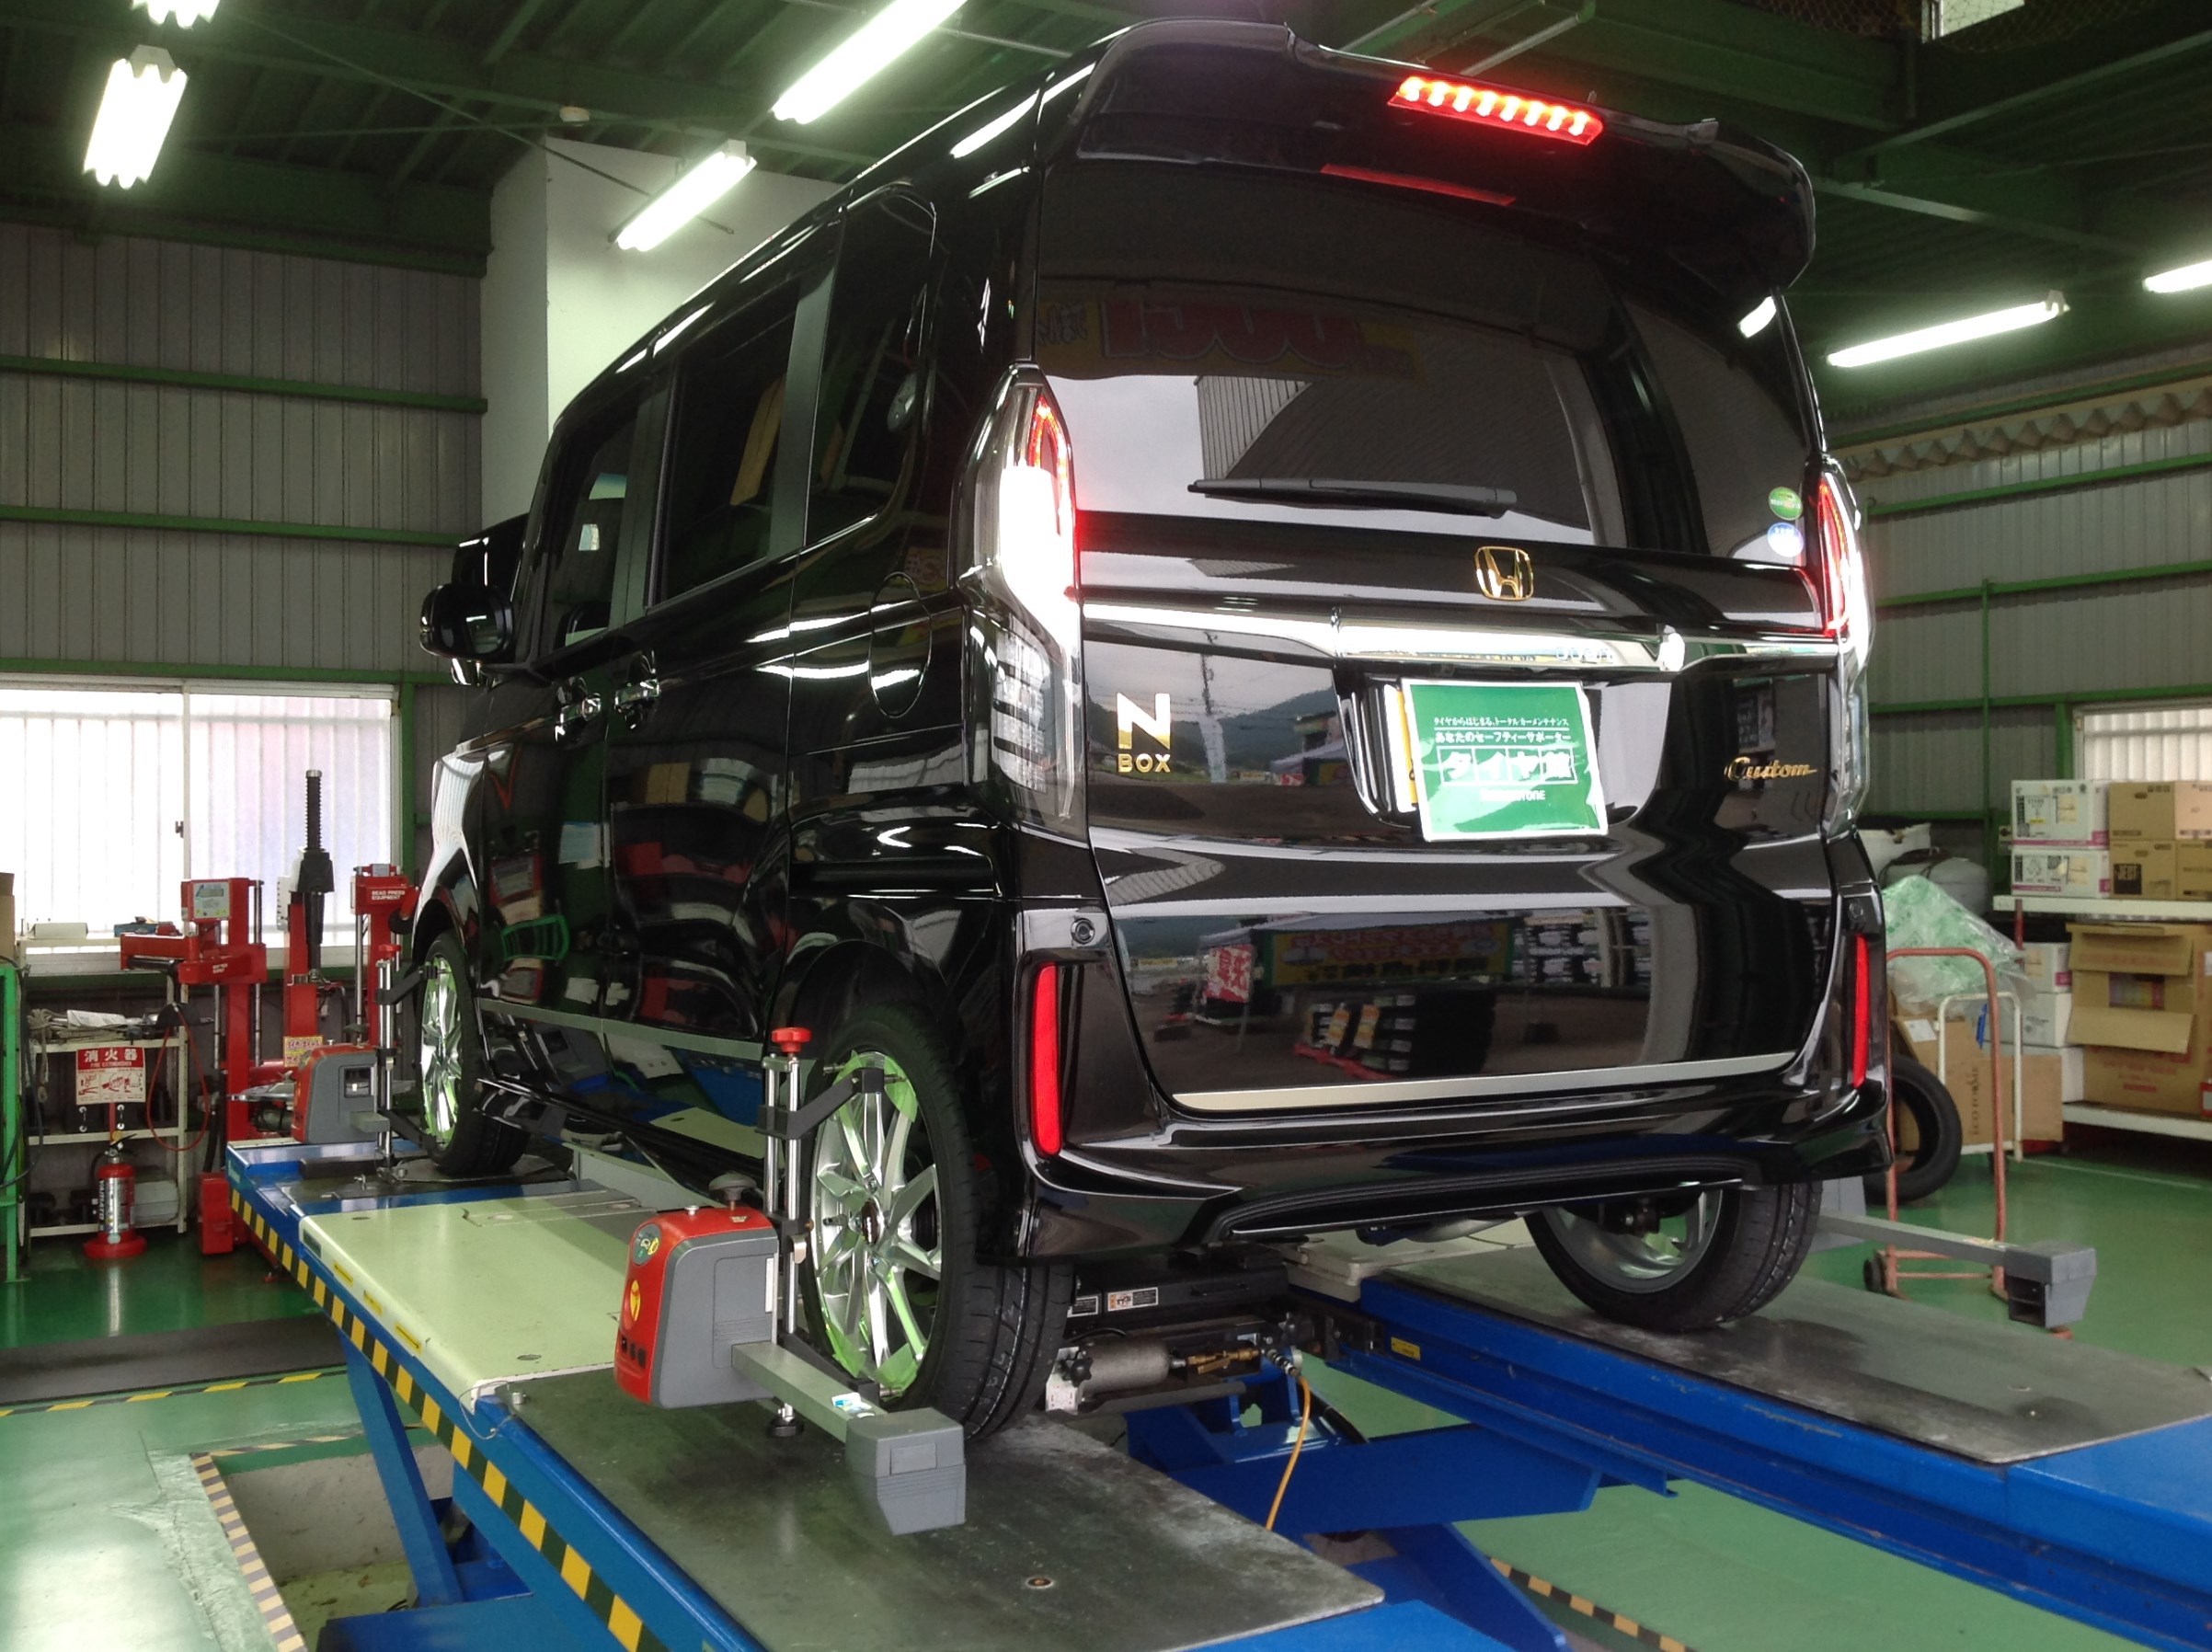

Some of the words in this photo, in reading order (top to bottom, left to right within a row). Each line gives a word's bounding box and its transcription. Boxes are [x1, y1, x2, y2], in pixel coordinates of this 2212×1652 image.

[1117, 693, 1170, 750] N
[1117, 753, 1171, 773] BOX
[1724, 756, 1817, 781] Custom
[84, 1049, 138, 1063] 消火器
